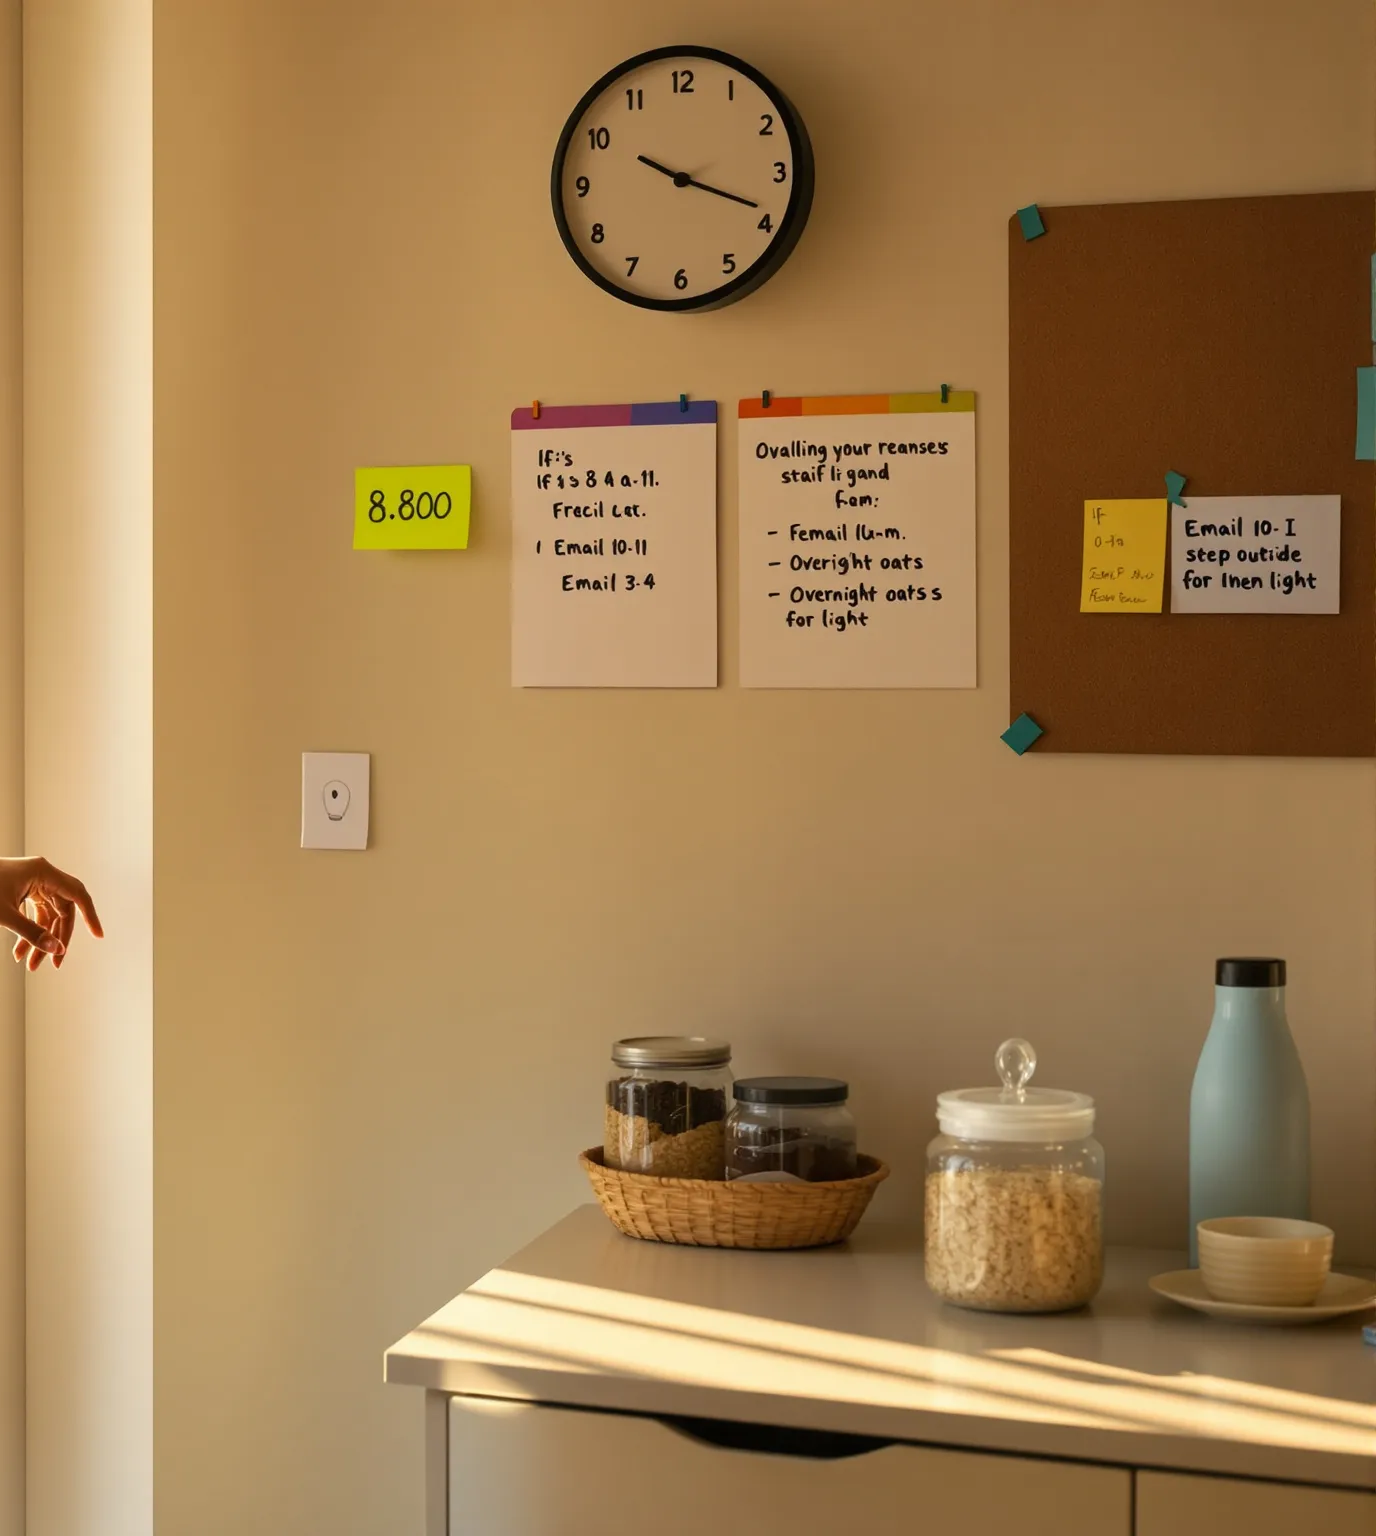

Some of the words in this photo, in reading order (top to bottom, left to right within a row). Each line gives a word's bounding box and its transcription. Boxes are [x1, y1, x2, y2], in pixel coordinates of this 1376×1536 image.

[671, 69, 694, 93] 12
[728, 79, 733, 100] 1
[625, 88, 642, 110] 11
[758, 113, 773, 135] 2
[587, 126, 610, 149] 10
[772, 161, 786, 183] 3
[575, 175, 590, 197] 9
[590, 222, 604, 243] 8
[756, 213, 773, 233] 4
[625, 256, 639, 277] 7
[722, 253, 735, 274] 5
[673, 268, 688, 290] 6
[755, 440, 827, 463] Ovalling
[832, 442, 872, 462] your
[368, 489, 451, 523] 8.800
[1184, 516, 1242, 537] Email
[554, 538, 603, 555] Email
[1186, 547, 1230, 566] step
[879, 553, 923, 570] oats
[561, 572, 615, 591] Email
[625, 572, 655, 590] 3-4
[1182, 568, 1212, 589] for
[1269, 569, 1316, 595] light
[789, 582, 877, 607] Overnight
[785, 610, 814, 627] for
[821, 608, 868, 632] light
